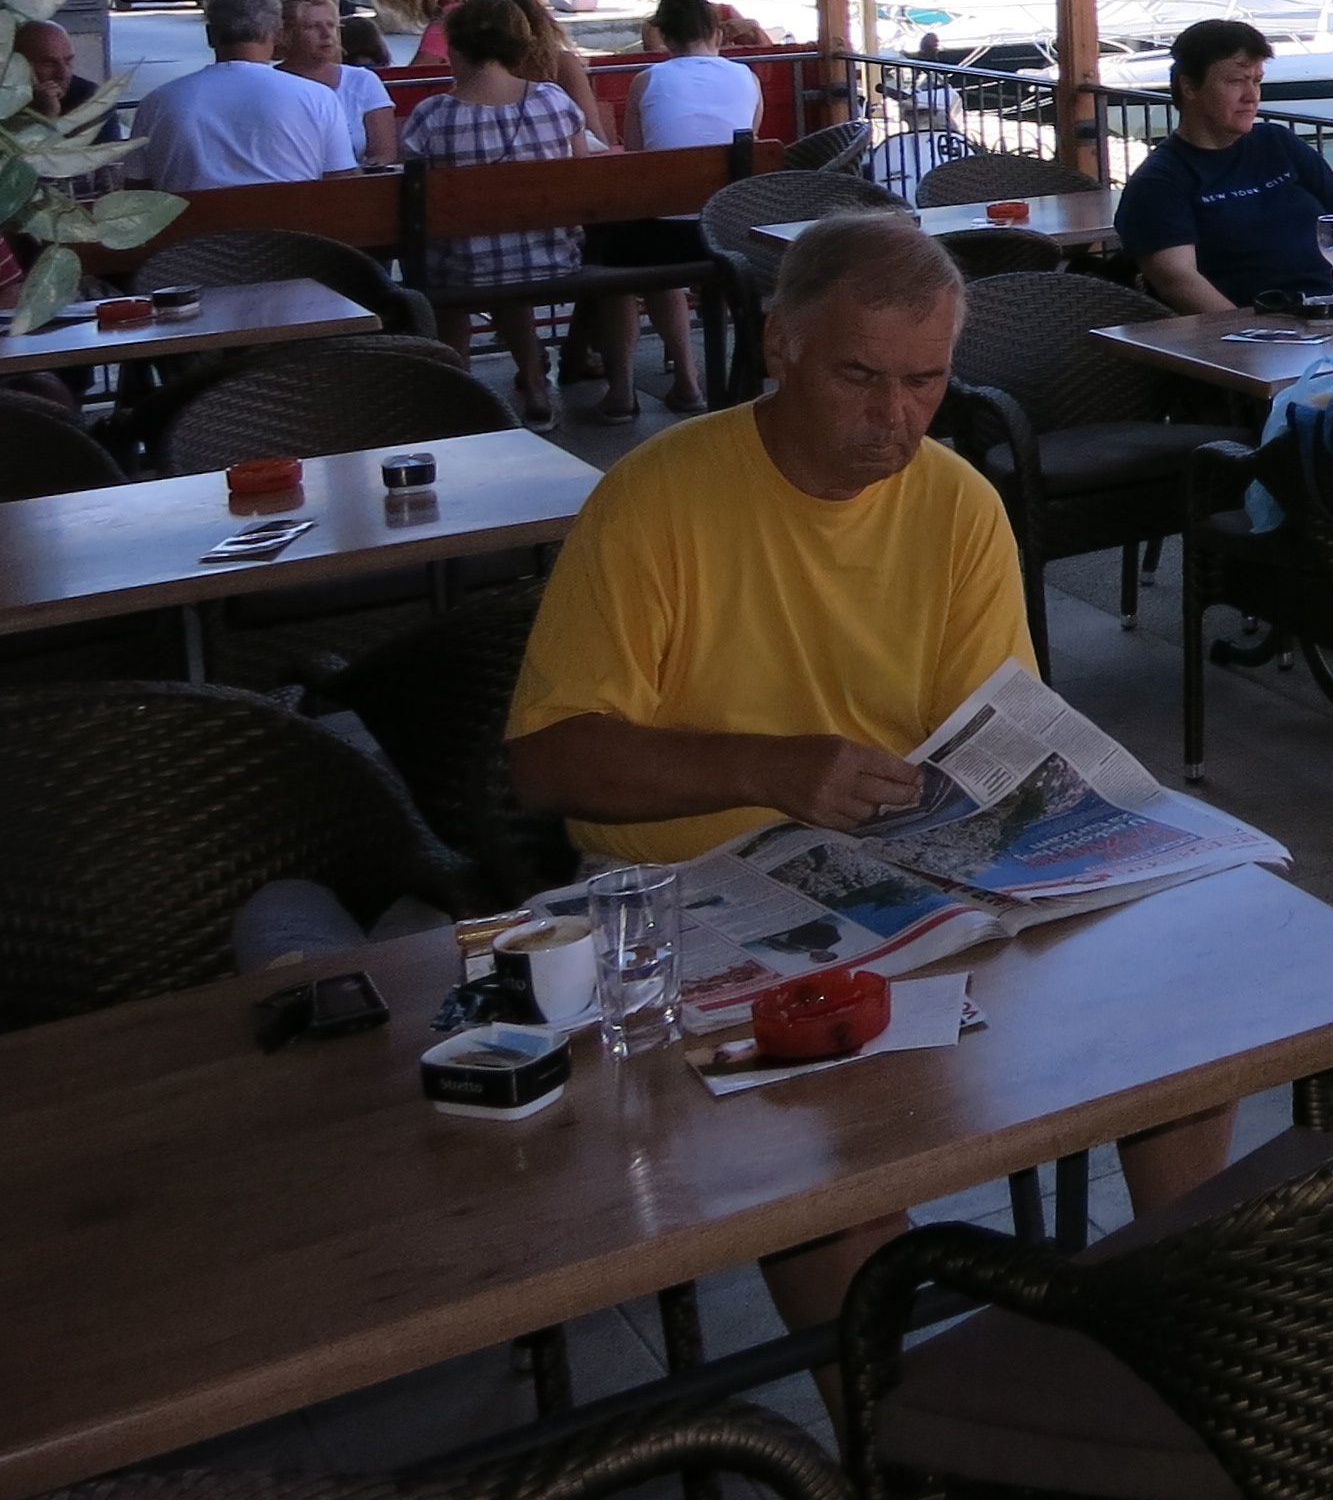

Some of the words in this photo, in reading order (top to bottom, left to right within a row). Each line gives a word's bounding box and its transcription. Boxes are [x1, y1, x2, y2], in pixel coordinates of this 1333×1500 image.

[1201, 192, 1226, 204] NEW
[1230, 187, 1262, 198] YORK
[1265, 171, 1292, 189] CITY
